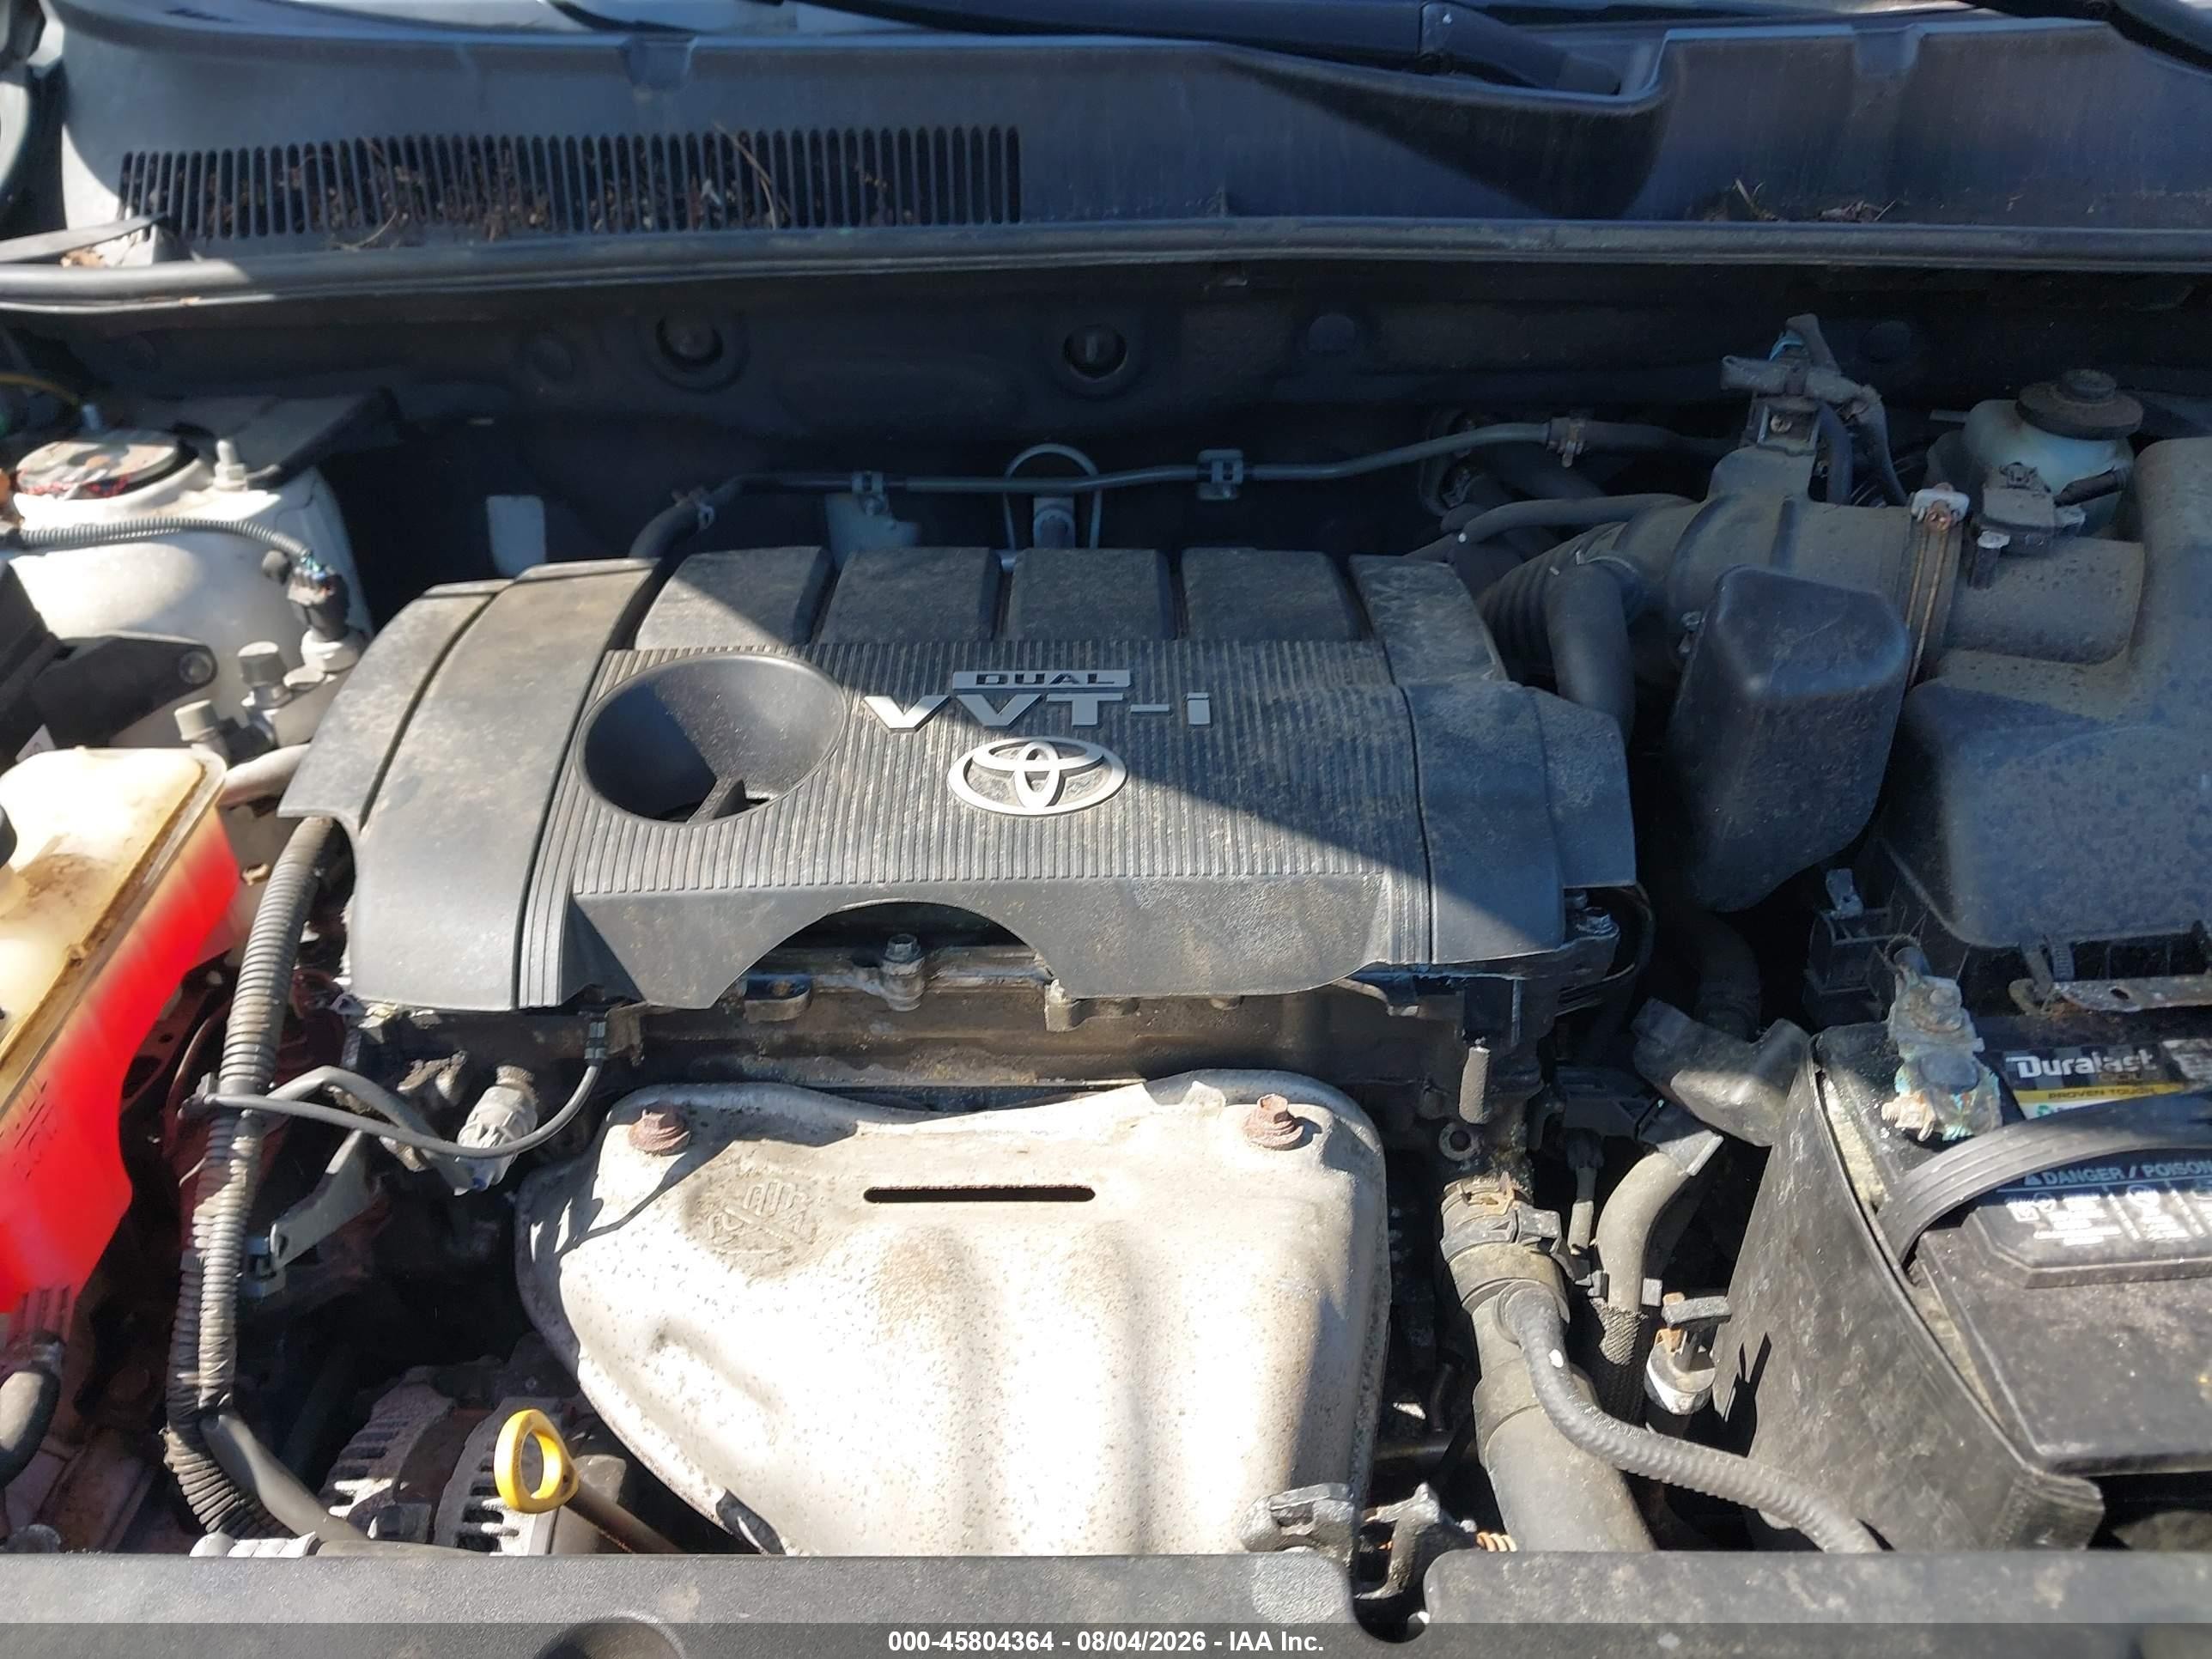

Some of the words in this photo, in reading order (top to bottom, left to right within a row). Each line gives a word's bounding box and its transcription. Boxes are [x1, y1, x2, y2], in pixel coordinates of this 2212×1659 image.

[975, 672, 1115, 686] DUAL
[862, 691, 1212, 733] VVT-i
[2006, 1049, 2157, 1078] Duralast
[2048, 1090, 2104, 1100] PROVEN
[2041, 1166, 2124, 1185] DANGER
